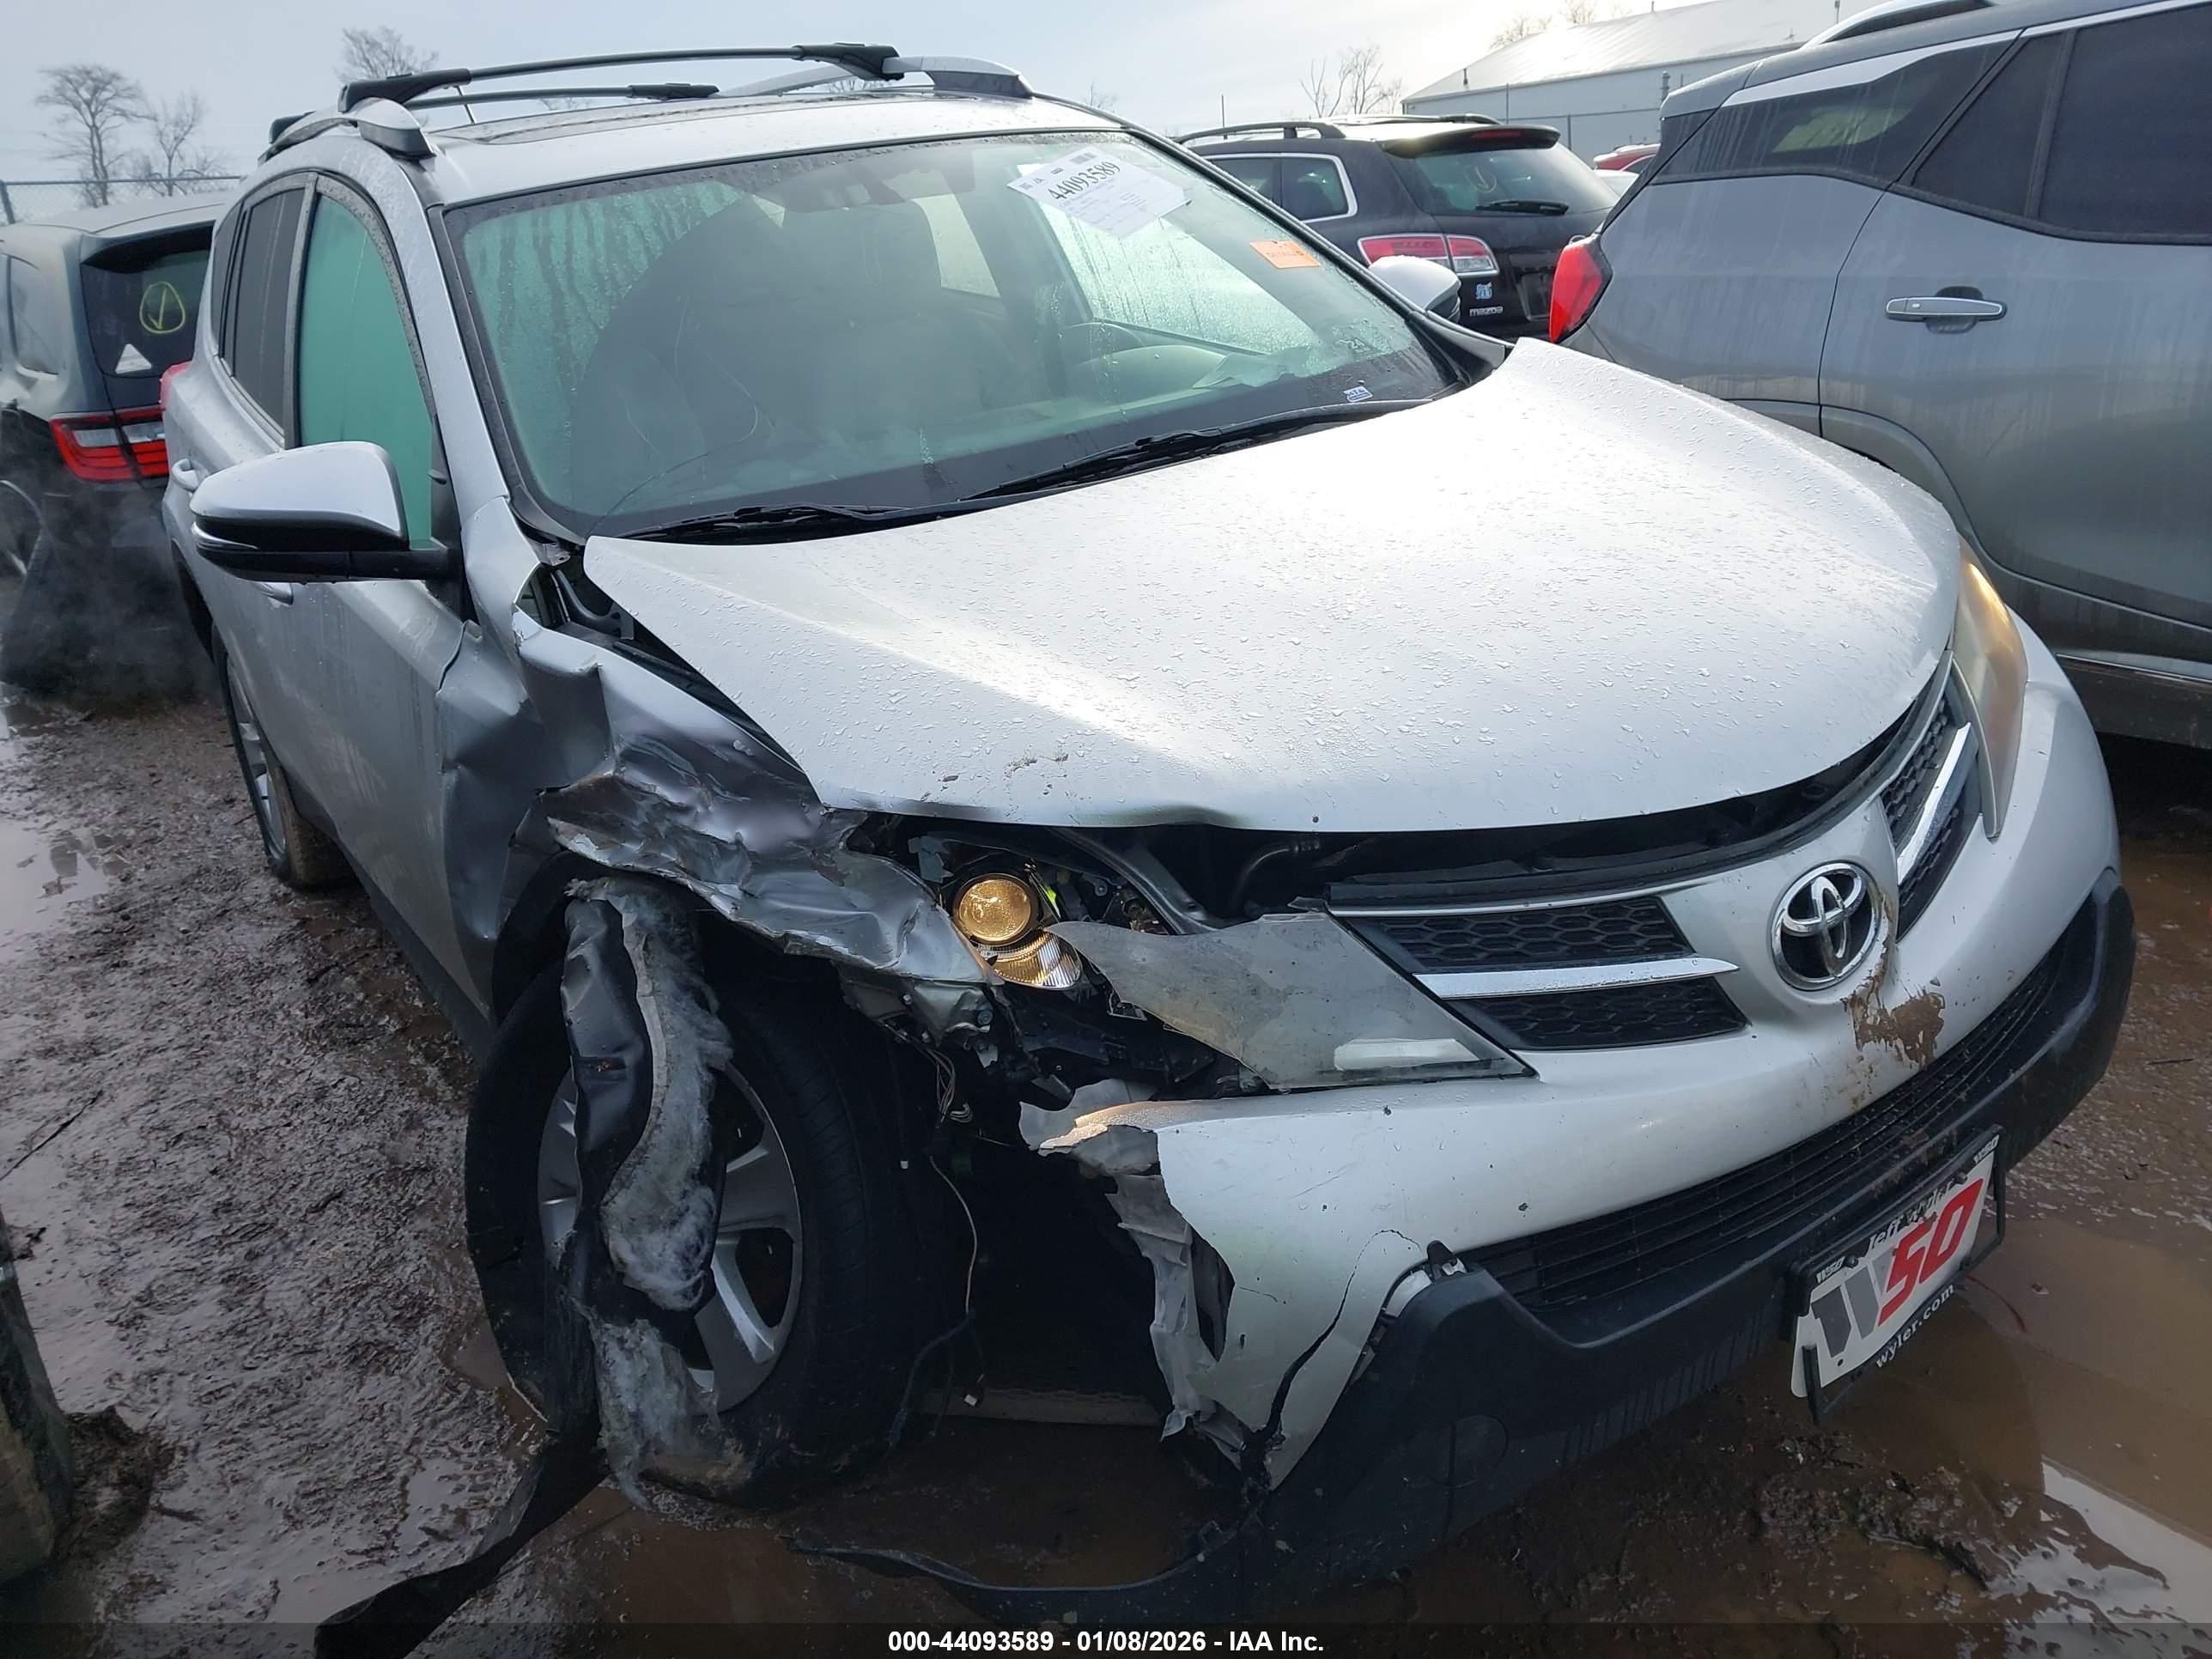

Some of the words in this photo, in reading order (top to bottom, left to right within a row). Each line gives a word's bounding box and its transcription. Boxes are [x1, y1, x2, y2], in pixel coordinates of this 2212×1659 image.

[1048, 161, 1121, 200] 44093589
[1469, 306, 1504, 317] mazda
[1875, 1284, 1954, 1368] wyler.com
